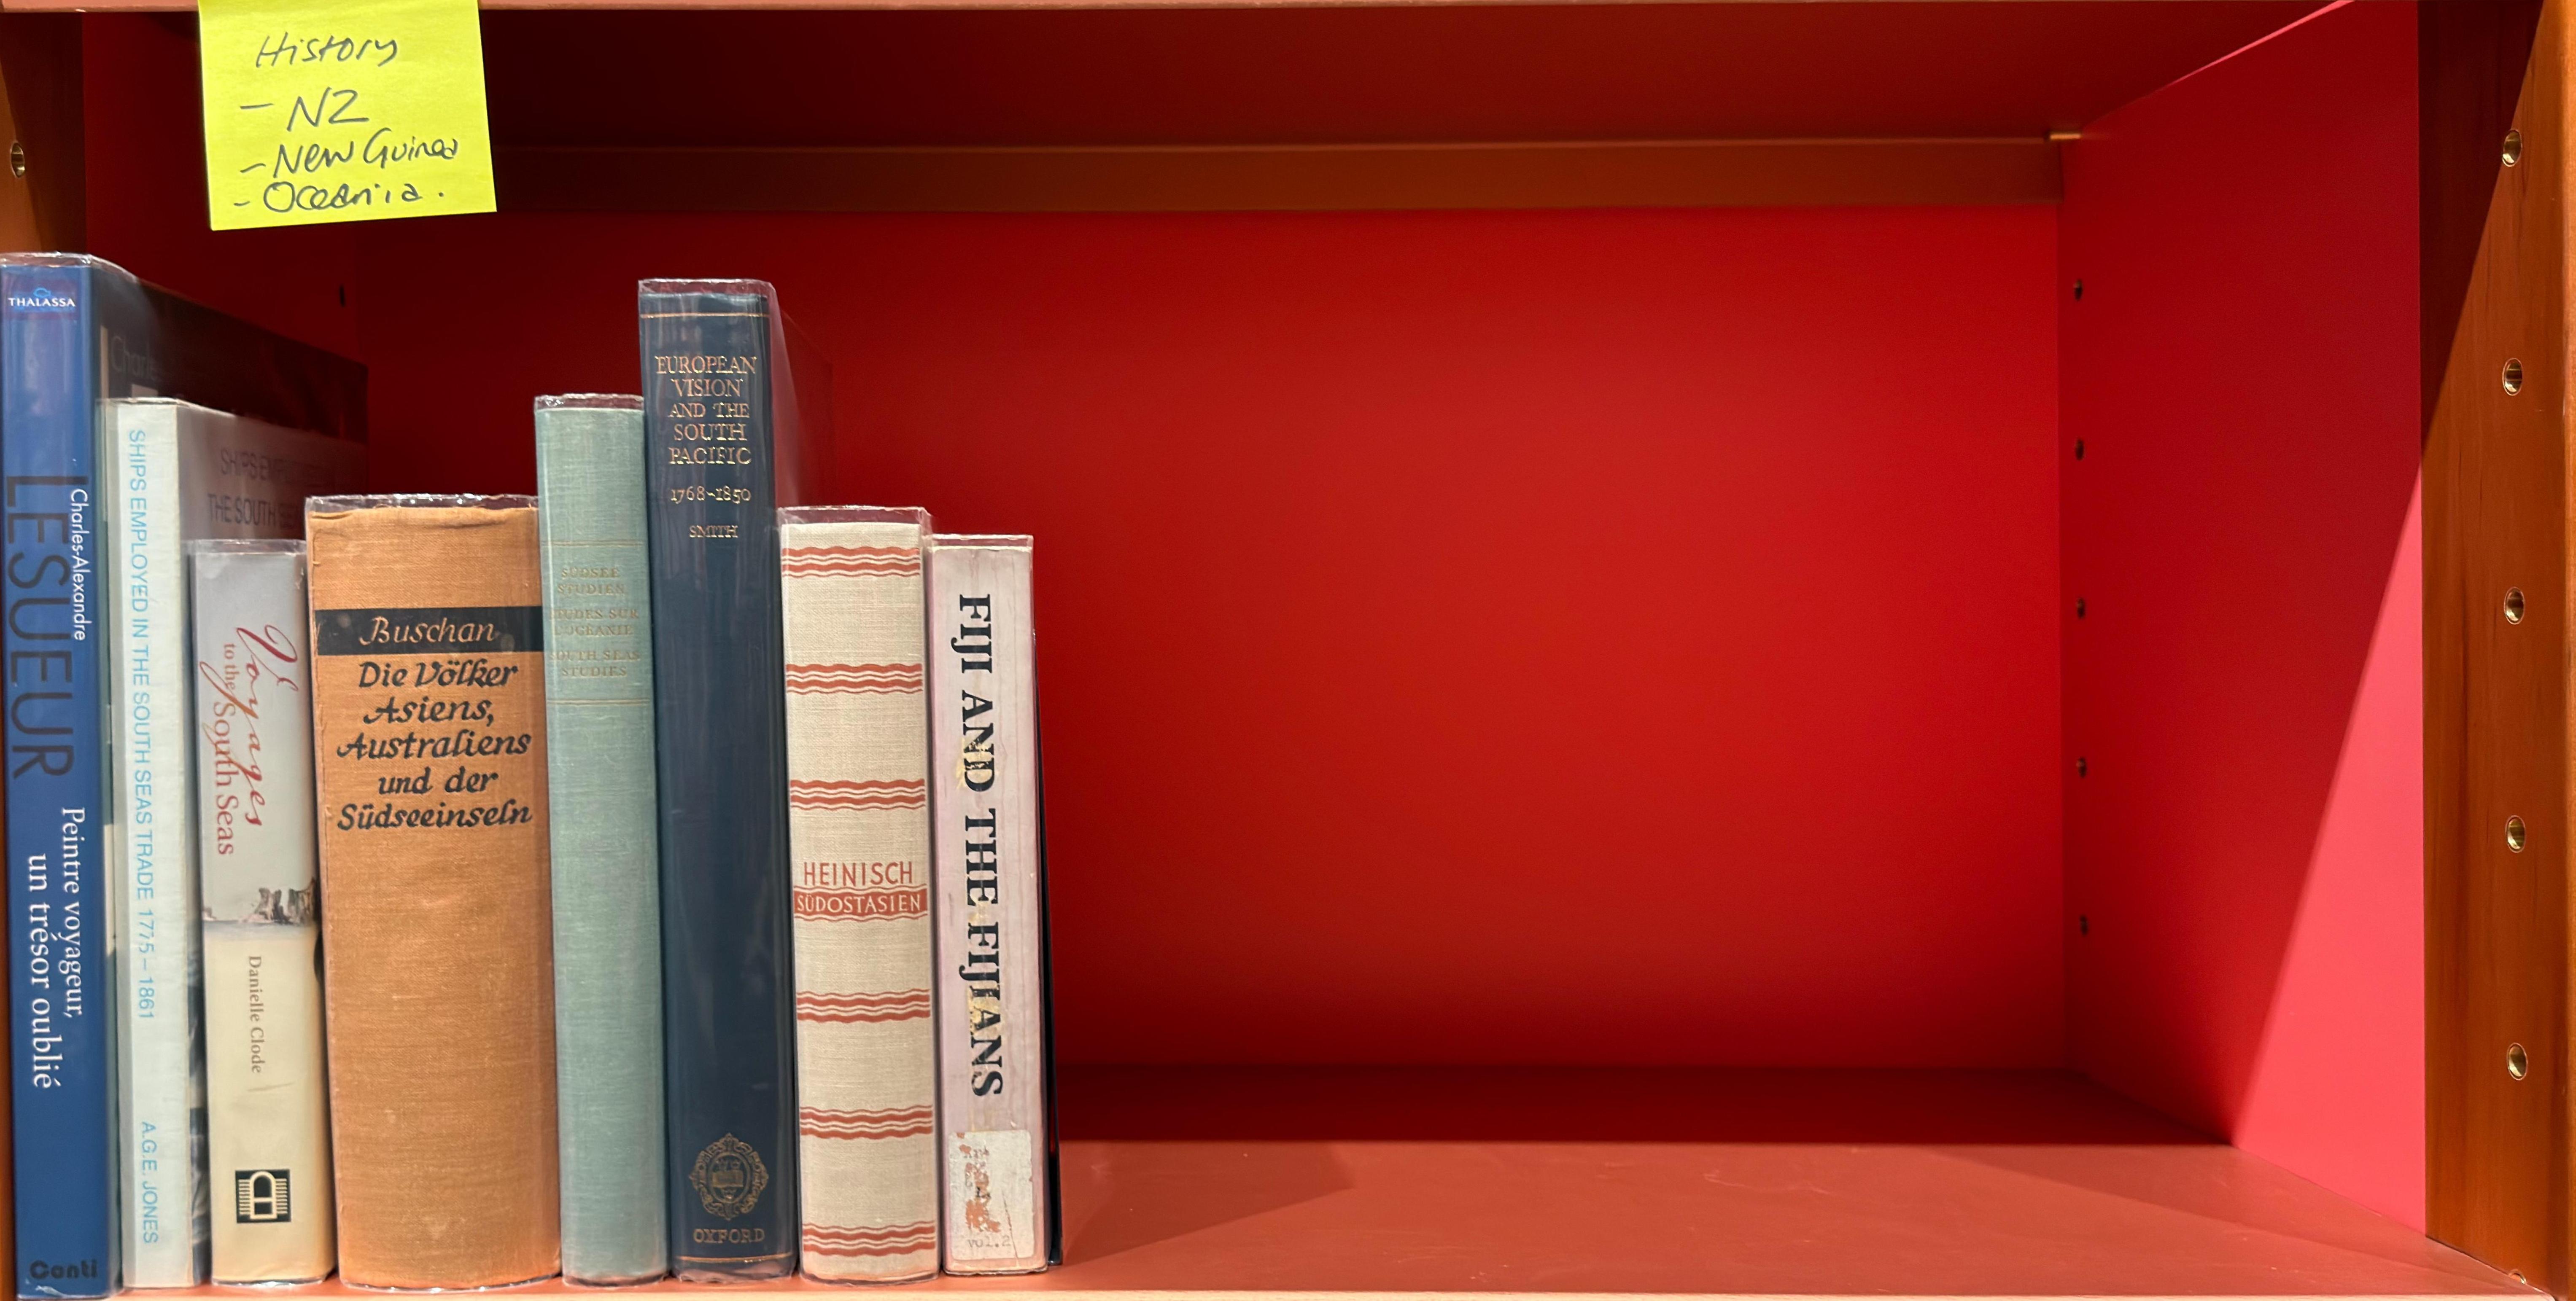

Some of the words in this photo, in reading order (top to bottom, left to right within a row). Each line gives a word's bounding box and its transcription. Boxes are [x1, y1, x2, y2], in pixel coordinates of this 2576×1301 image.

[256, 32, 397, 67] History
[287, 87, 369, 132] NZ
[273, 141, 354, 178] New
[363, 127, 458, 169] Guinea
[8, 297, 76, 307] THALASSA
[655, 355, 757, 374] EUROPEAN
[671, 379, 744, 397] VISION
[667, 403, 706, 418] AND
[712, 402, 750, 418] THE
[674, 423, 748, 441] SOUTH
[129, 429, 147, 492] SHIPS
[668, 447, 752, 465] PACIFIC
[207, 493, 232, 523] THE
[234, 497, 277, 527] SOUTH
[671, 485, 752, 504] 1768-1850
[689, 525, 739, 538] SMITH
[70, 488, 92, 641] Charles-Alexandre
[130, 498, 148, 613] EMPLOYED
[6, 476, 89, 780] LESUEUR
[132, 618, 148, 637] IN
[359, 616, 495, 646] Buschan
[951, 594, 992, 674] FIJI
[132, 644, 150, 686] THE
[224, 643, 236, 660] to
[562, 666, 628, 677] STUDIES
[224, 663, 237, 691] the
[358, 661, 408, 688] Die
[414, 658, 518, 688] Völker
[133, 693, 152, 763] SOUTH
[199, 625, 299, 826] Voyages
[363, 696, 495, 727] Asiens,
[213, 702, 240, 787] South
[336, 729, 532, 760] Australiens
[962, 689, 996, 793] AND
[135, 770, 153, 825] SEAS
[378, 766, 434, 795] und
[444, 766, 499, 794] der
[216, 794, 239, 855] Seas
[337, 798, 533, 831] Südseeinseln
[61, 807, 86, 894] Peintre
[135, 830, 155, 900] TRADE
[965, 808, 999, 906] THE
[28, 853, 47, 892] un
[803, 861, 913, 887] HEINISCH
[797, 893, 921, 913] SÜDOSTASIEN
[30, 903, 58, 989] trésor
[57, 900, 83, 1018] voyageur,
[248, 954, 264, 1022] Danielle
[959, 921, 1003, 1097] FIJIANS
[32, 997, 63, 1089] oublié
[250, 1026, 267, 1074] Clode
[141, 1121, 158, 1176] A.G.E.
[143, 1181, 159, 1244] JONES
[693, 1228, 765, 1243] OXFORD
[29, 1258, 98, 1280] Conti
